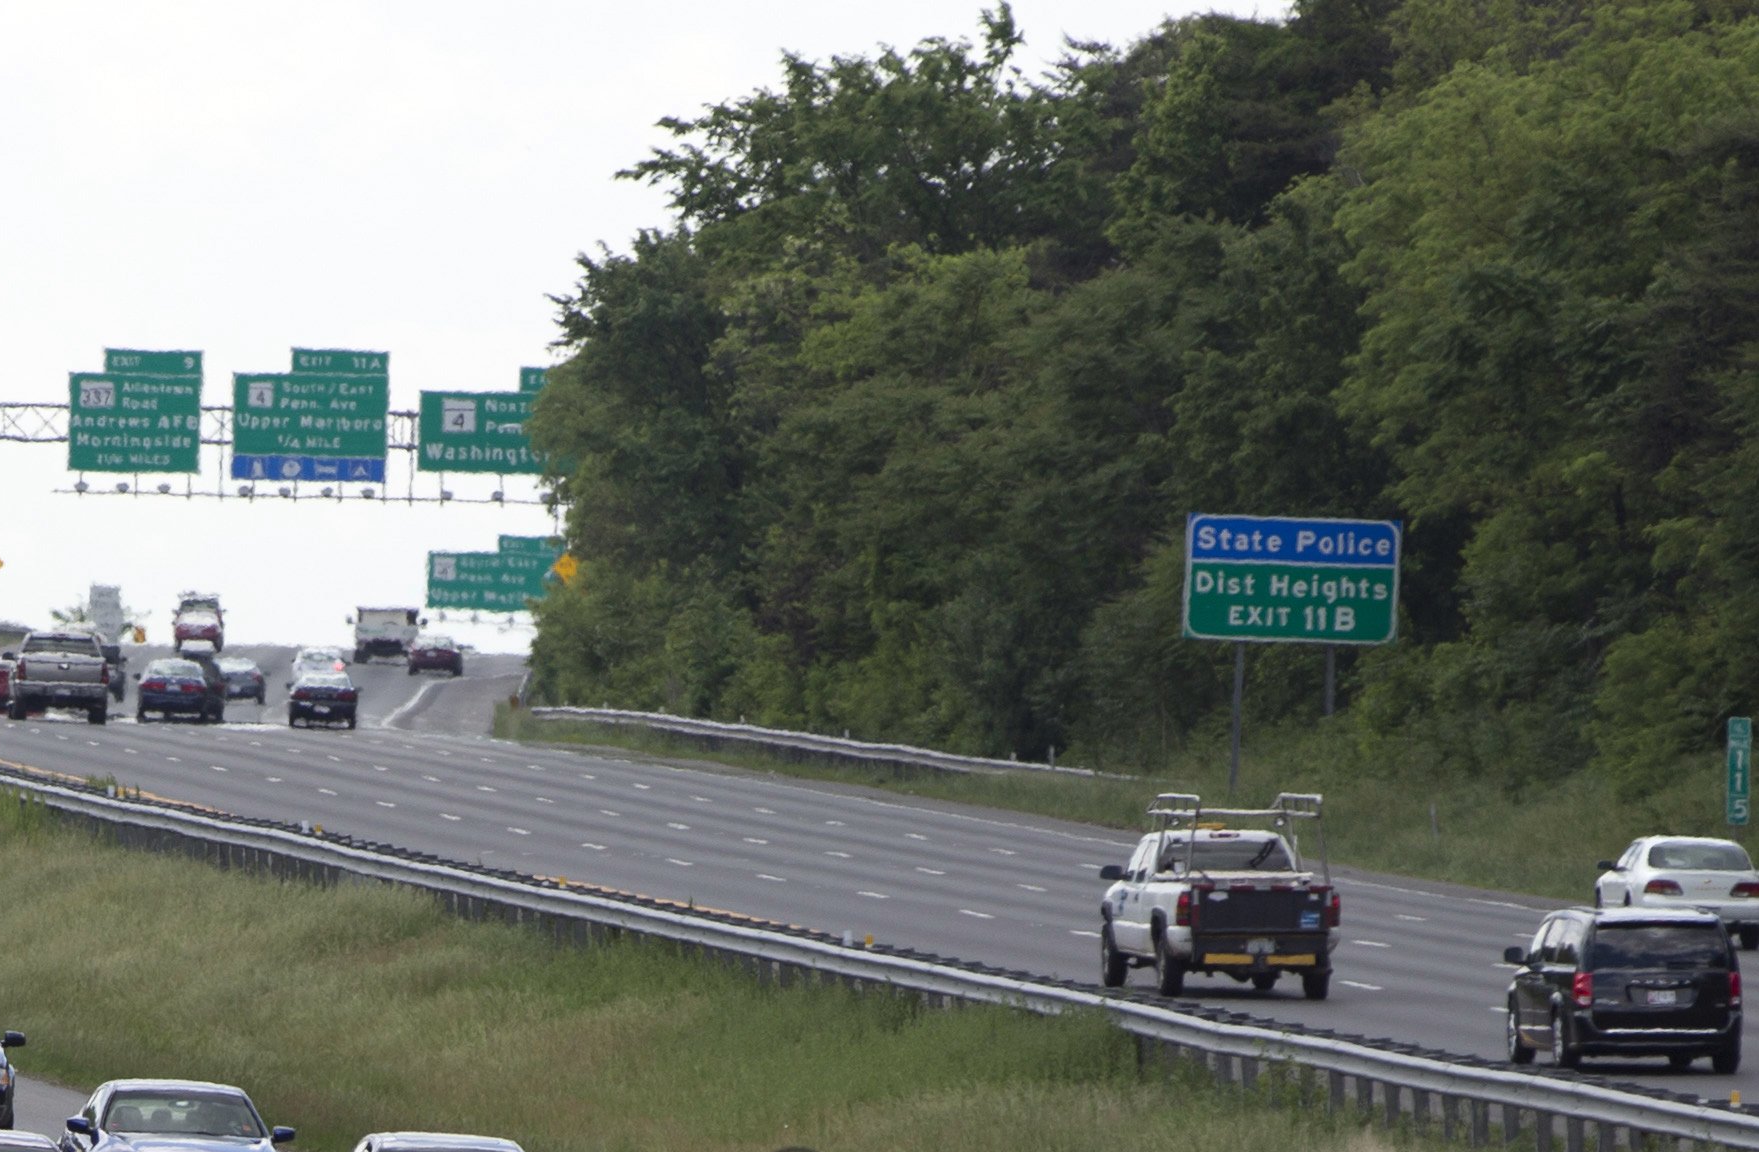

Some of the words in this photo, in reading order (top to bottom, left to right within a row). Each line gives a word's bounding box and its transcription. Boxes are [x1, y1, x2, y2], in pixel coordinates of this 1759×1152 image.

[183, 356, 195, 369] 9
[299, 355, 332, 367] EXIT
[256, 390, 265, 404] 4
[330, 399, 357, 410] Ave
[72, 414, 151, 428] Andrews
[237, 413, 290, 429] Upper
[299, 415, 383, 432] Marlboro
[452, 413, 465, 428] 4
[76, 432, 192, 449] Morningside
[306, 435, 341, 448] MILE
[1197, 525, 1283, 552] State
[1296, 530, 1391, 557] Police
[1195, 570, 1256, 596] Dist
[1269, 574, 1388, 604] Heights
[1228, 605, 1291, 627] EXIT
[1303, 605, 1357, 632] 11B
